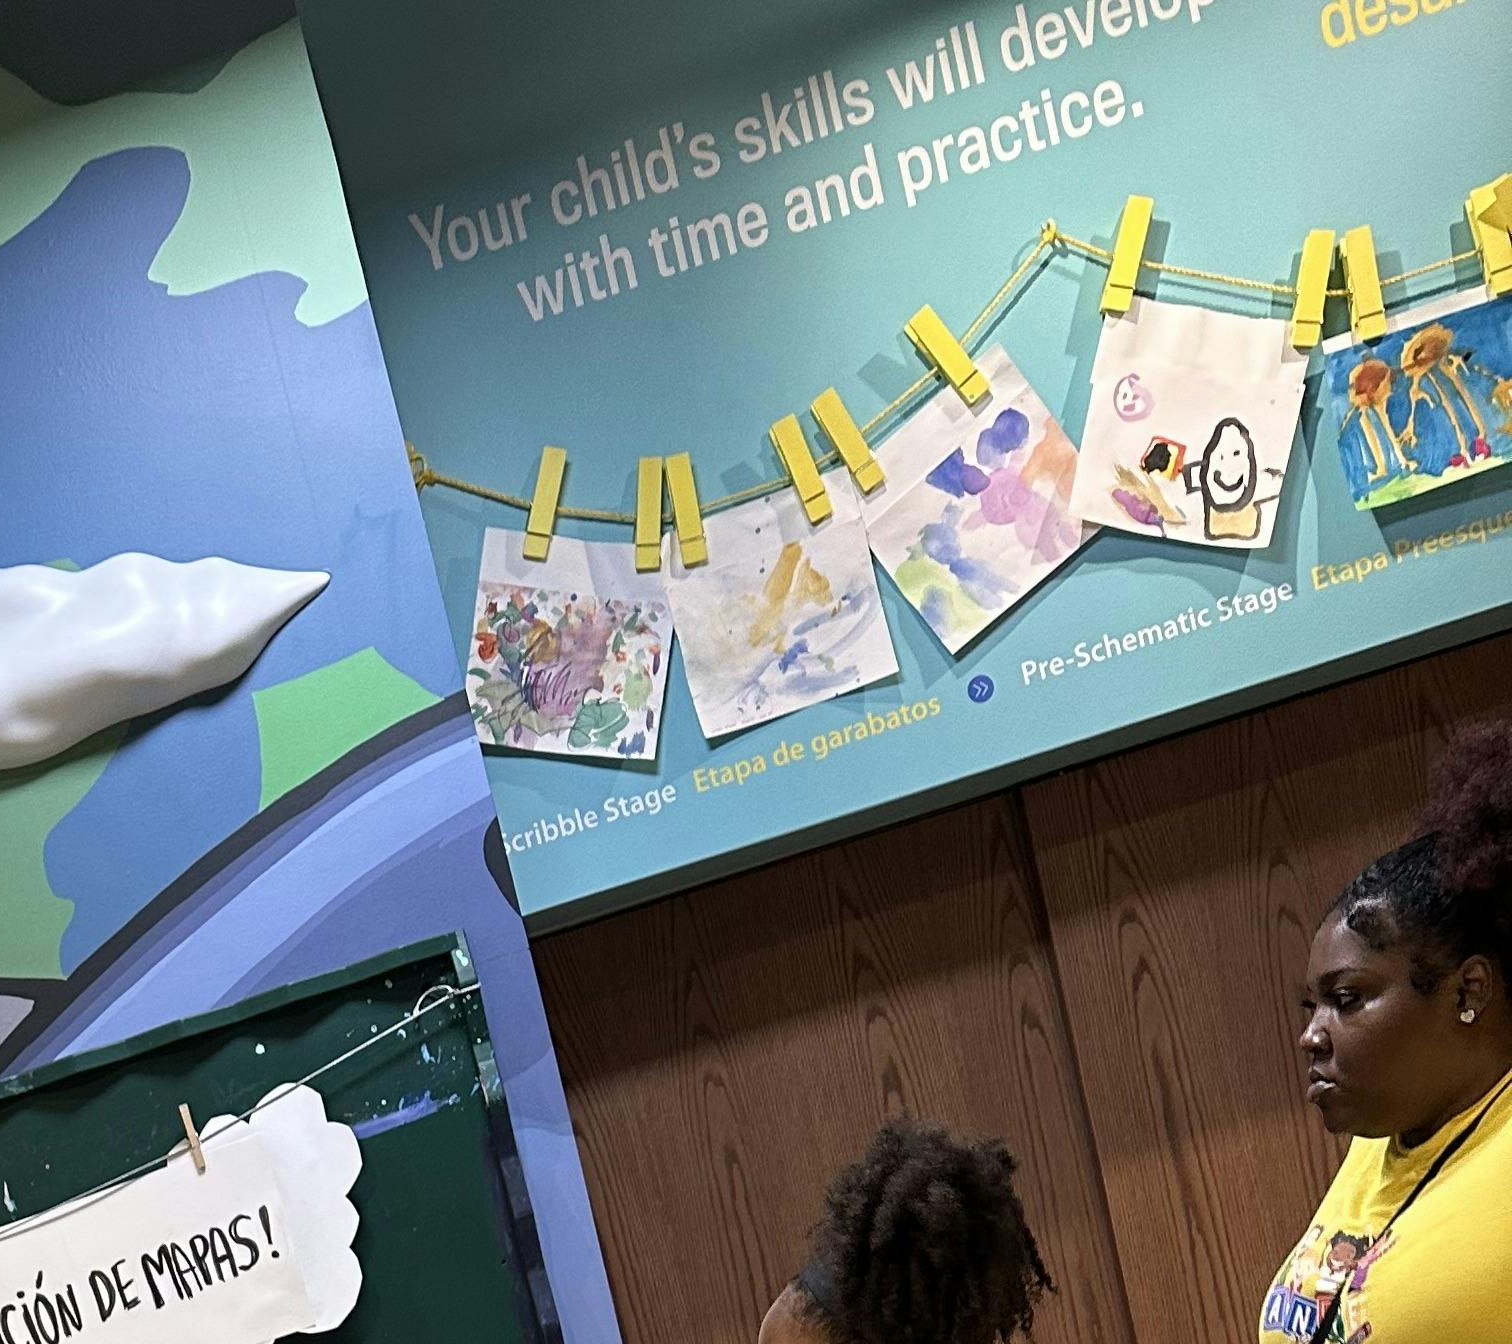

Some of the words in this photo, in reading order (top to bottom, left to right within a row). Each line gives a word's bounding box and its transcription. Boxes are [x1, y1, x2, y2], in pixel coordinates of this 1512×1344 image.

[408, 193, 531, 270] Your
[550, 122, 721, 226] child's
[734, 70, 874, 163] skills
[886, 20, 985, 109] will
[517, 235, 638, 321] with
[648, 202, 769, 277] time
[785, 143, 885, 233] and
[897, 80, 1144, 206] practice.
[1021, 605, 1212, 685] Pre-Schematic
[1215, 579, 1293, 621] Stage
[1311, 551, 1388, 591] Etapa
[604, 784, 676, 822] Stage
[693, 758, 767, 793] Etapa
[773, 741, 804, 769] de
[811, 696, 941, 759] garabatos
[89, 1259, 141, 1322] DE
[141, 1205, 280, 1310] MAPAS!
